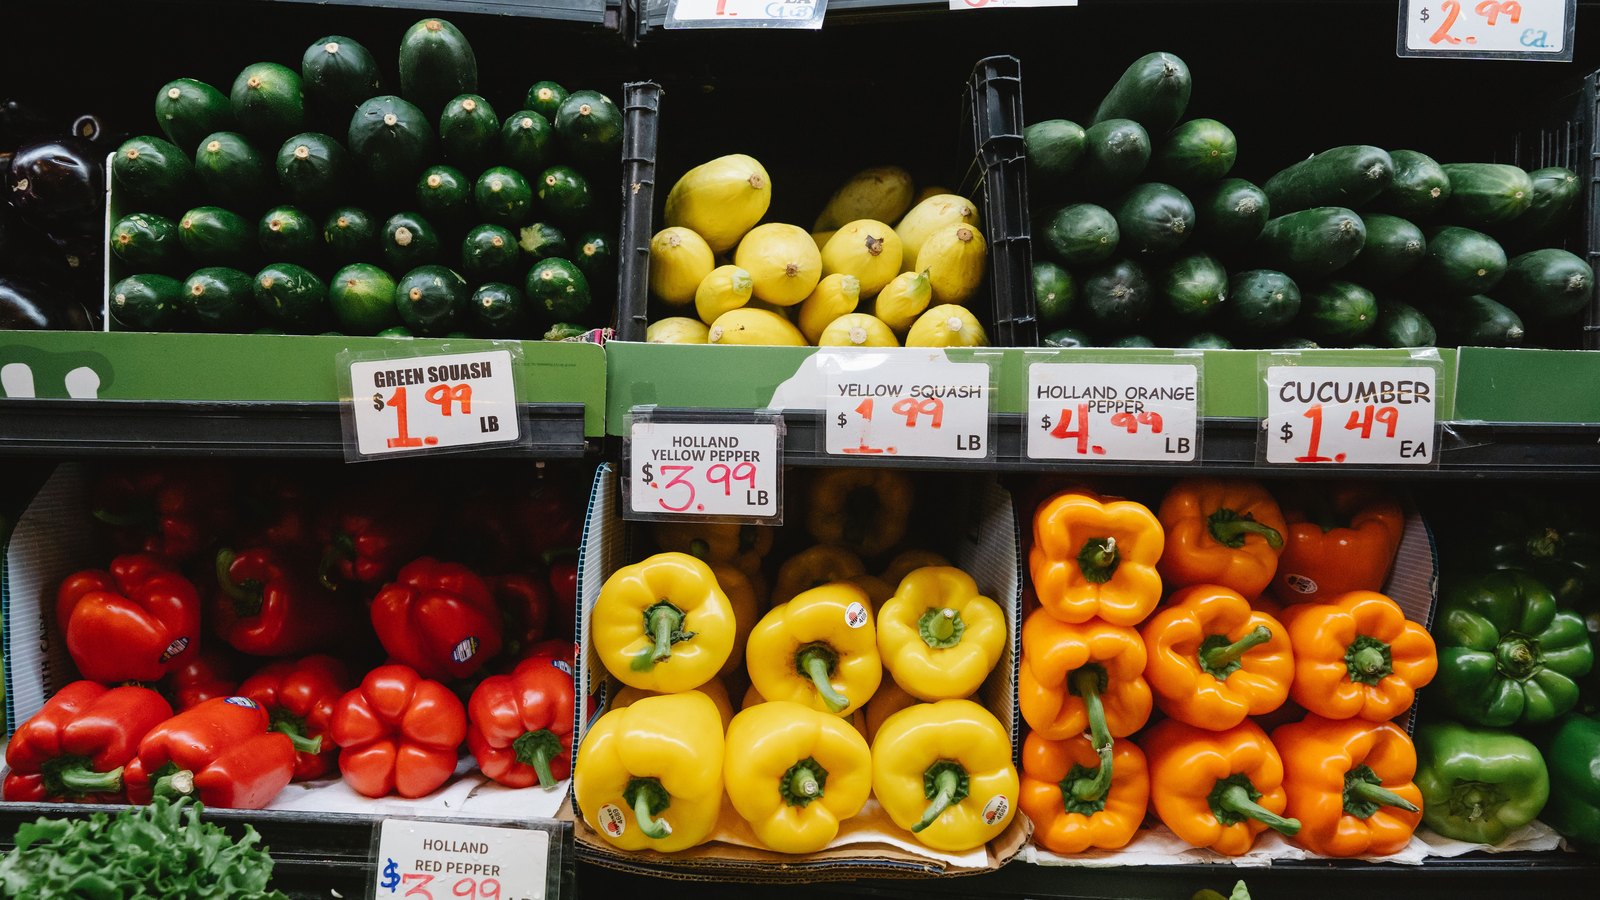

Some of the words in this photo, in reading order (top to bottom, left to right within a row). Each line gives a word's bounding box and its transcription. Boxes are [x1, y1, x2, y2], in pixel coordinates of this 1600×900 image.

[373, 367, 425, 388] GREEN
[427, 361, 493, 383] SQUASH
[838, 383, 903, 397] YELLOW
[910, 384, 982, 400] SQUASH
[1037, 385, 1118, 399] HOLLAND
[1125, 387, 1195, 401] ORANGE
[1279, 380, 1431, 404] CUCUMBER
[1088, 400, 1145, 414] PEPPER
[480, 415, 500, 433] LB
[672, 436, 739, 448] HOLLAND
[956, 434, 981, 451] LB
[1165, 437, 1190, 454] LB
[1400, 440, 1427, 458] EA
[651, 449, 706, 461] YELLOW
[710, 450, 760, 462] PEPPER
[746, 490, 769, 506] LB
[423, 838, 489, 855] HOLLAND
[415, 859, 442, 873] RED
[446, 861, 501, 877] PEPPER
